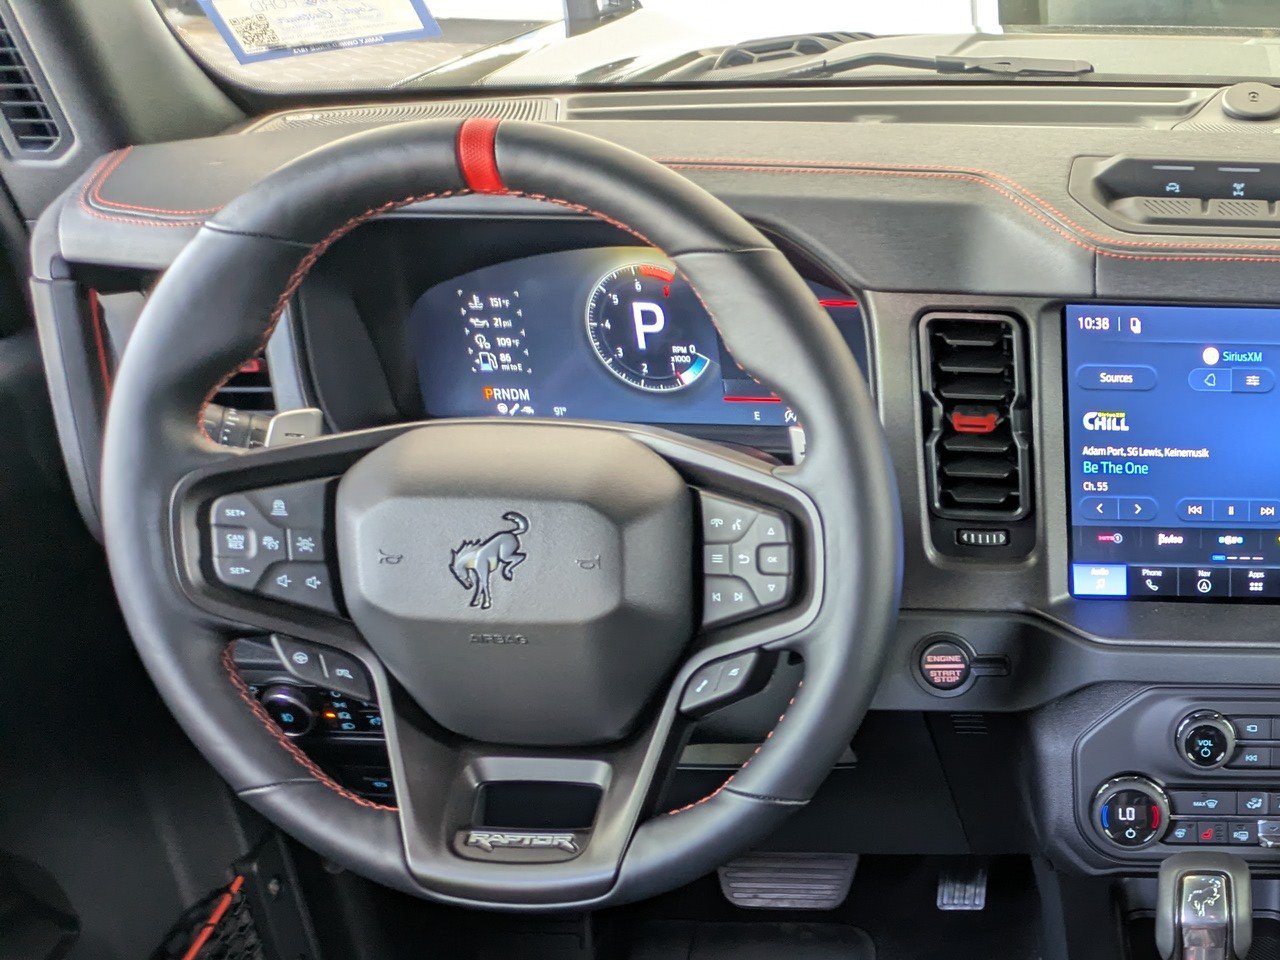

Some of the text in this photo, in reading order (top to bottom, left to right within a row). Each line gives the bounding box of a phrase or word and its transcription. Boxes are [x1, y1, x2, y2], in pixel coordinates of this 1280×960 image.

[612, 295, 619, 305] 5
[604, 319, 611, 330] 4
[632, 302, 665, 350] P
[1077, 317, 1110, 330] 10:38
[617, 347, 624, 358] 3
[672, 345, 688, 354] RPM
[1222, 351, 1262, 363] SiriusXM
[1099, 372, 1133, 384] Sources
[754, 411, 761, 421] E
[1082, 446, 1210, 458] Adam Port, SG Lewis, Keinemusik
[1083, 461, 1149, 475] Be The One
[1097, 482, 1109, 491] 55
[226, 533, 245, 541] CAN
[228, 541, 245, 550] RES
[1141, 568, 1163, 577] Phone
[1198, 569, 1211, 577] Nav
[1248, 570, 1265, 579] Apps
[470, 633, 529, 645] AIRBAG
[929, 669, 962, 677] START
[1198, 739, 1213, 747] VOL
[1118, 807, 1136, 821] LO
[467, 832, 581, 853] RAPTOR
